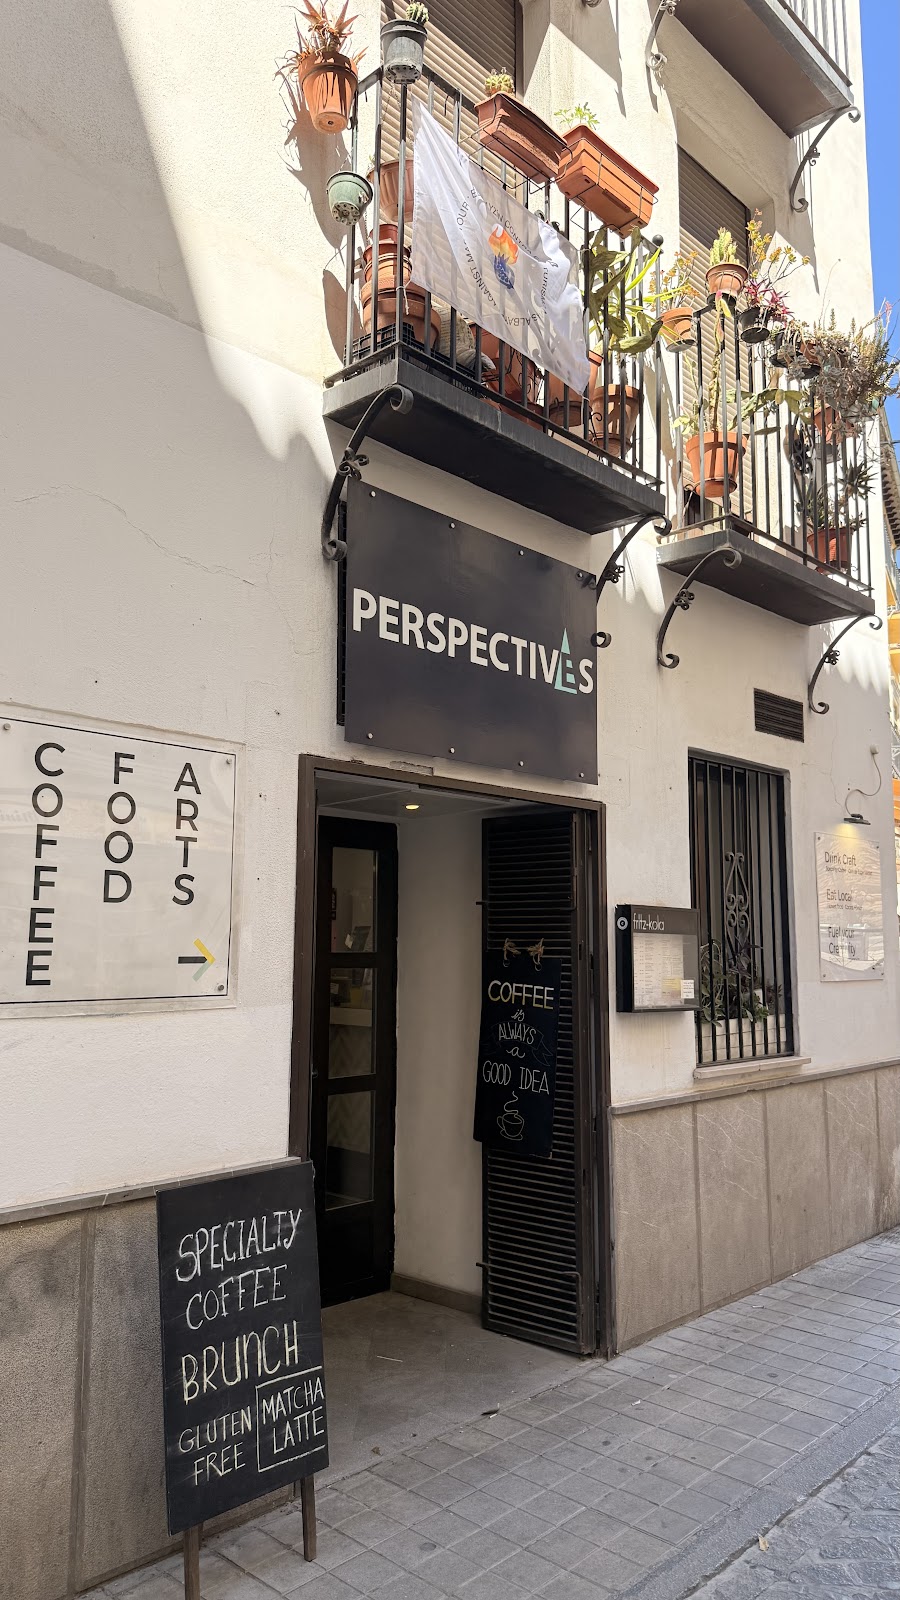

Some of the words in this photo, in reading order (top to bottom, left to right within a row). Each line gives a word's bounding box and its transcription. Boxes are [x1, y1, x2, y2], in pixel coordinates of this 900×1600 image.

[353, 588, 594, 694] PERSPECTIVES
[103, 751, 137, 904] FOOD
[172, 762, 202, 906] ARTS
[26, 742, 66, 986] COFFEE
[824, 851, 841, 865] Drink
[842, 853, 857, 867] Craft
[838, 890, 853, 902] Local
[633, 913, 665, 931] fritz-kola
[828, 927, 841, 939] Fuel
[487, 979, 554, 1010] COFFEE
[510, 1009, 525, 1022] is
[498, 1022, 537, 1045] ALWAYS
[506, 1046, 526, 1059] a
[482, 1060, 511, 1086] GOOD
[518, 1066, 550, 1095] IDEA
[175, 1208, 303, 1283] SPECIALTY
[186, 1264, 288, 1331] COFFEE
[261, 1377, 324, 1425] MATCHA
[178, 1405, 253, 1454] GLUTEN
[272, 1406, 325, 1455] LATTE
[192, 1442, 245, 1487] FREE
